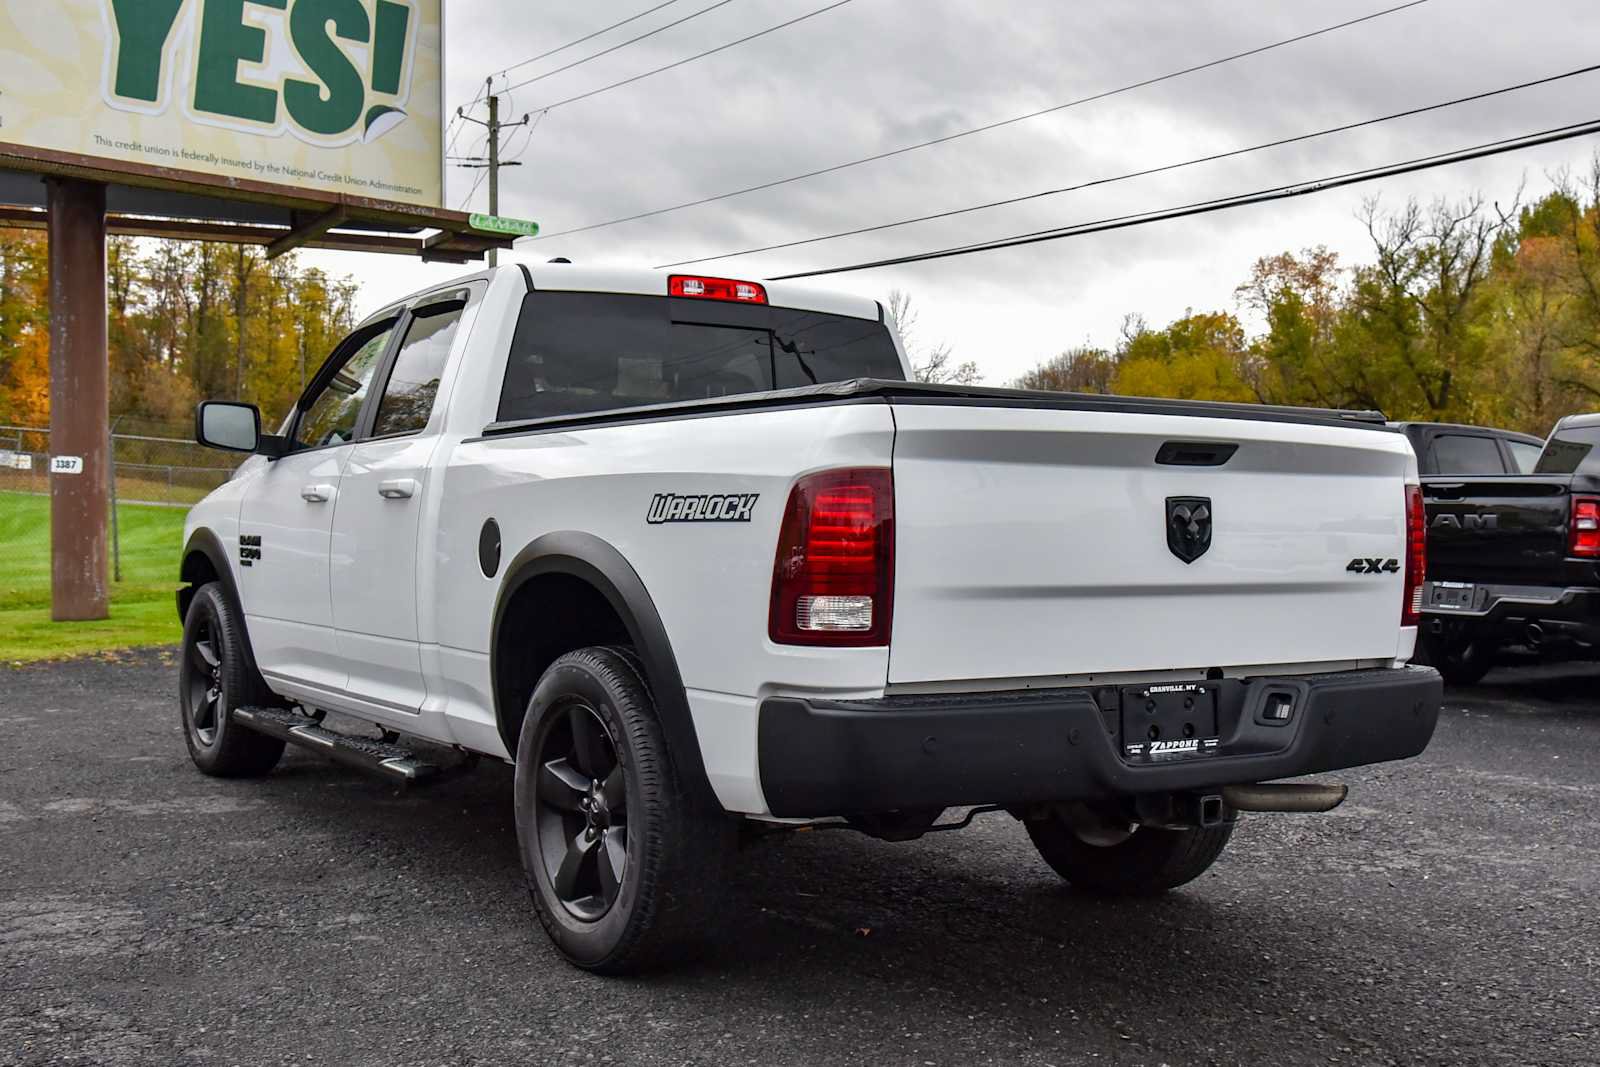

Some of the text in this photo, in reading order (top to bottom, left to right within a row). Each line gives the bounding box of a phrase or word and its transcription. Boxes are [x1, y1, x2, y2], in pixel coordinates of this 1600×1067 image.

[109, 0, 411, 135] YES!
[94, 135, 423, 195] This credit union is federally insured by the National Credit Union Administration
[647, 493, 760, 524] WARLOCK
[1424, 513, 1497, 529] AM
[1149, 739, 1199, 754] ZAPPONE
